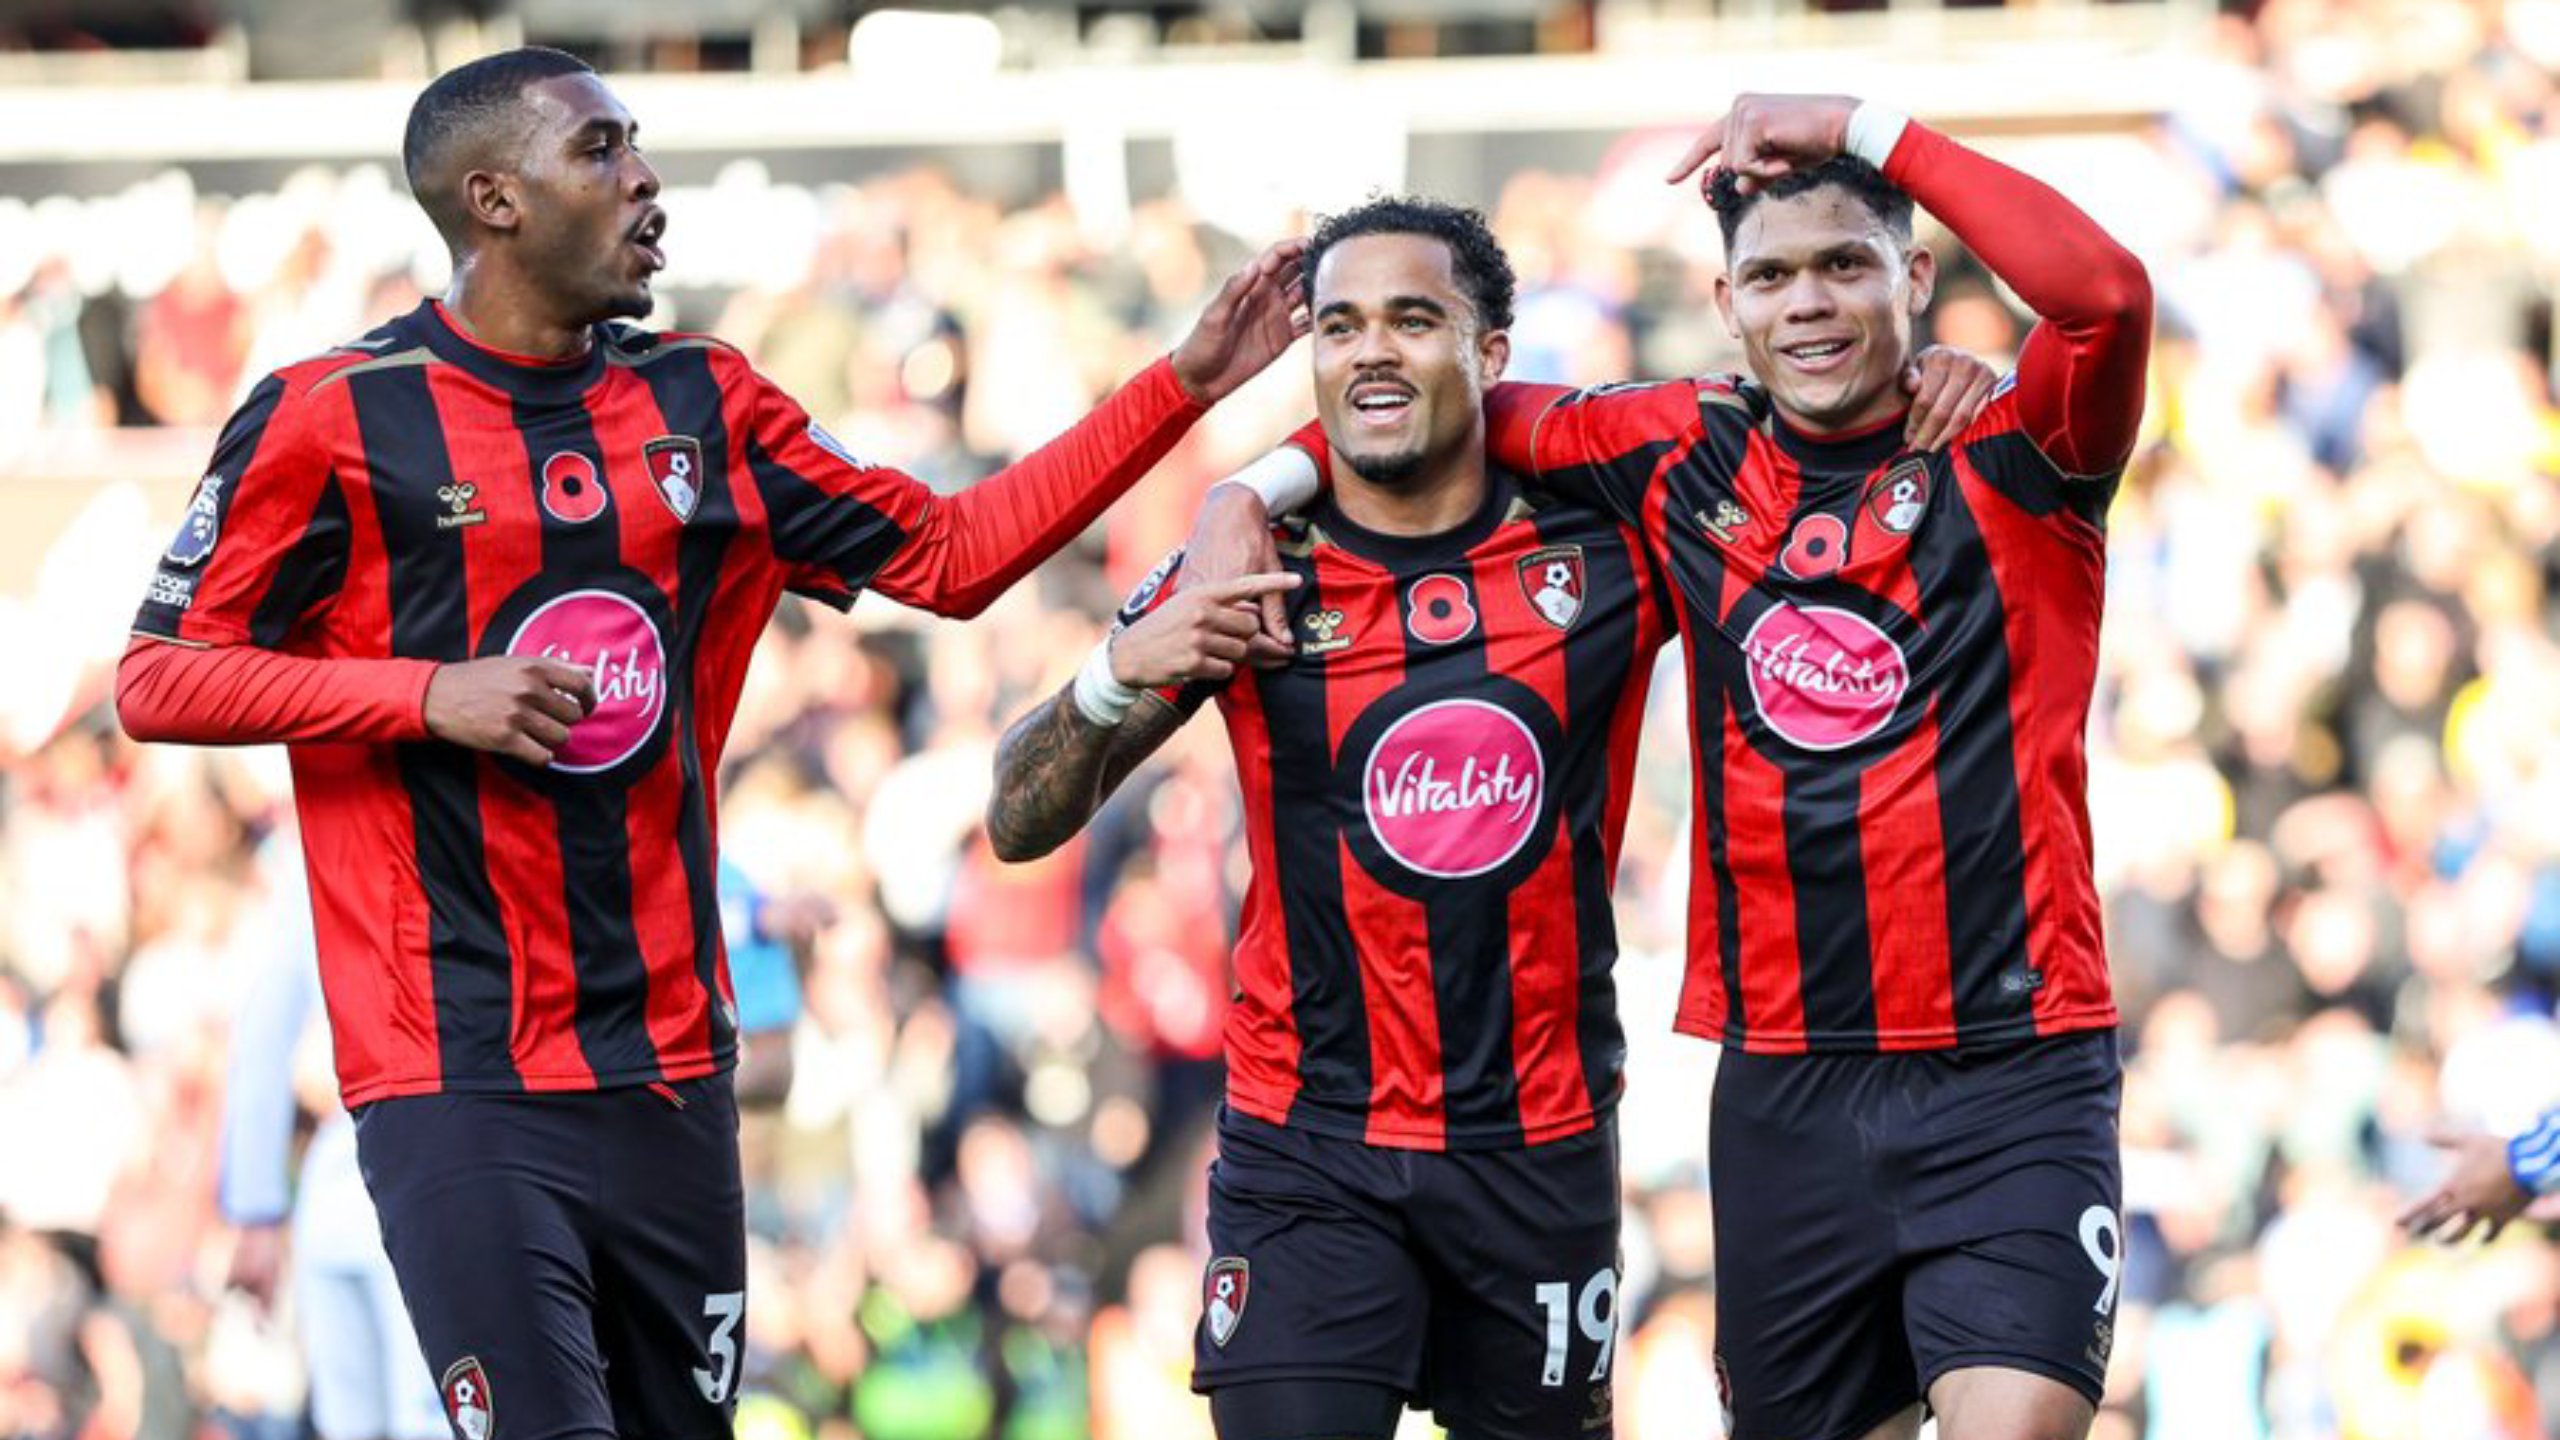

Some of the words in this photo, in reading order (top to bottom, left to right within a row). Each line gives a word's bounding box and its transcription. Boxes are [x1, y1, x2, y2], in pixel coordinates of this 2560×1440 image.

[1752, 633, 1895, 709] Vitality
[1376, 750, 1534, 822] Vitality
[2078, 1205, 2120, 1316] 9
[1535, 1267, 1618, 1387] 19
